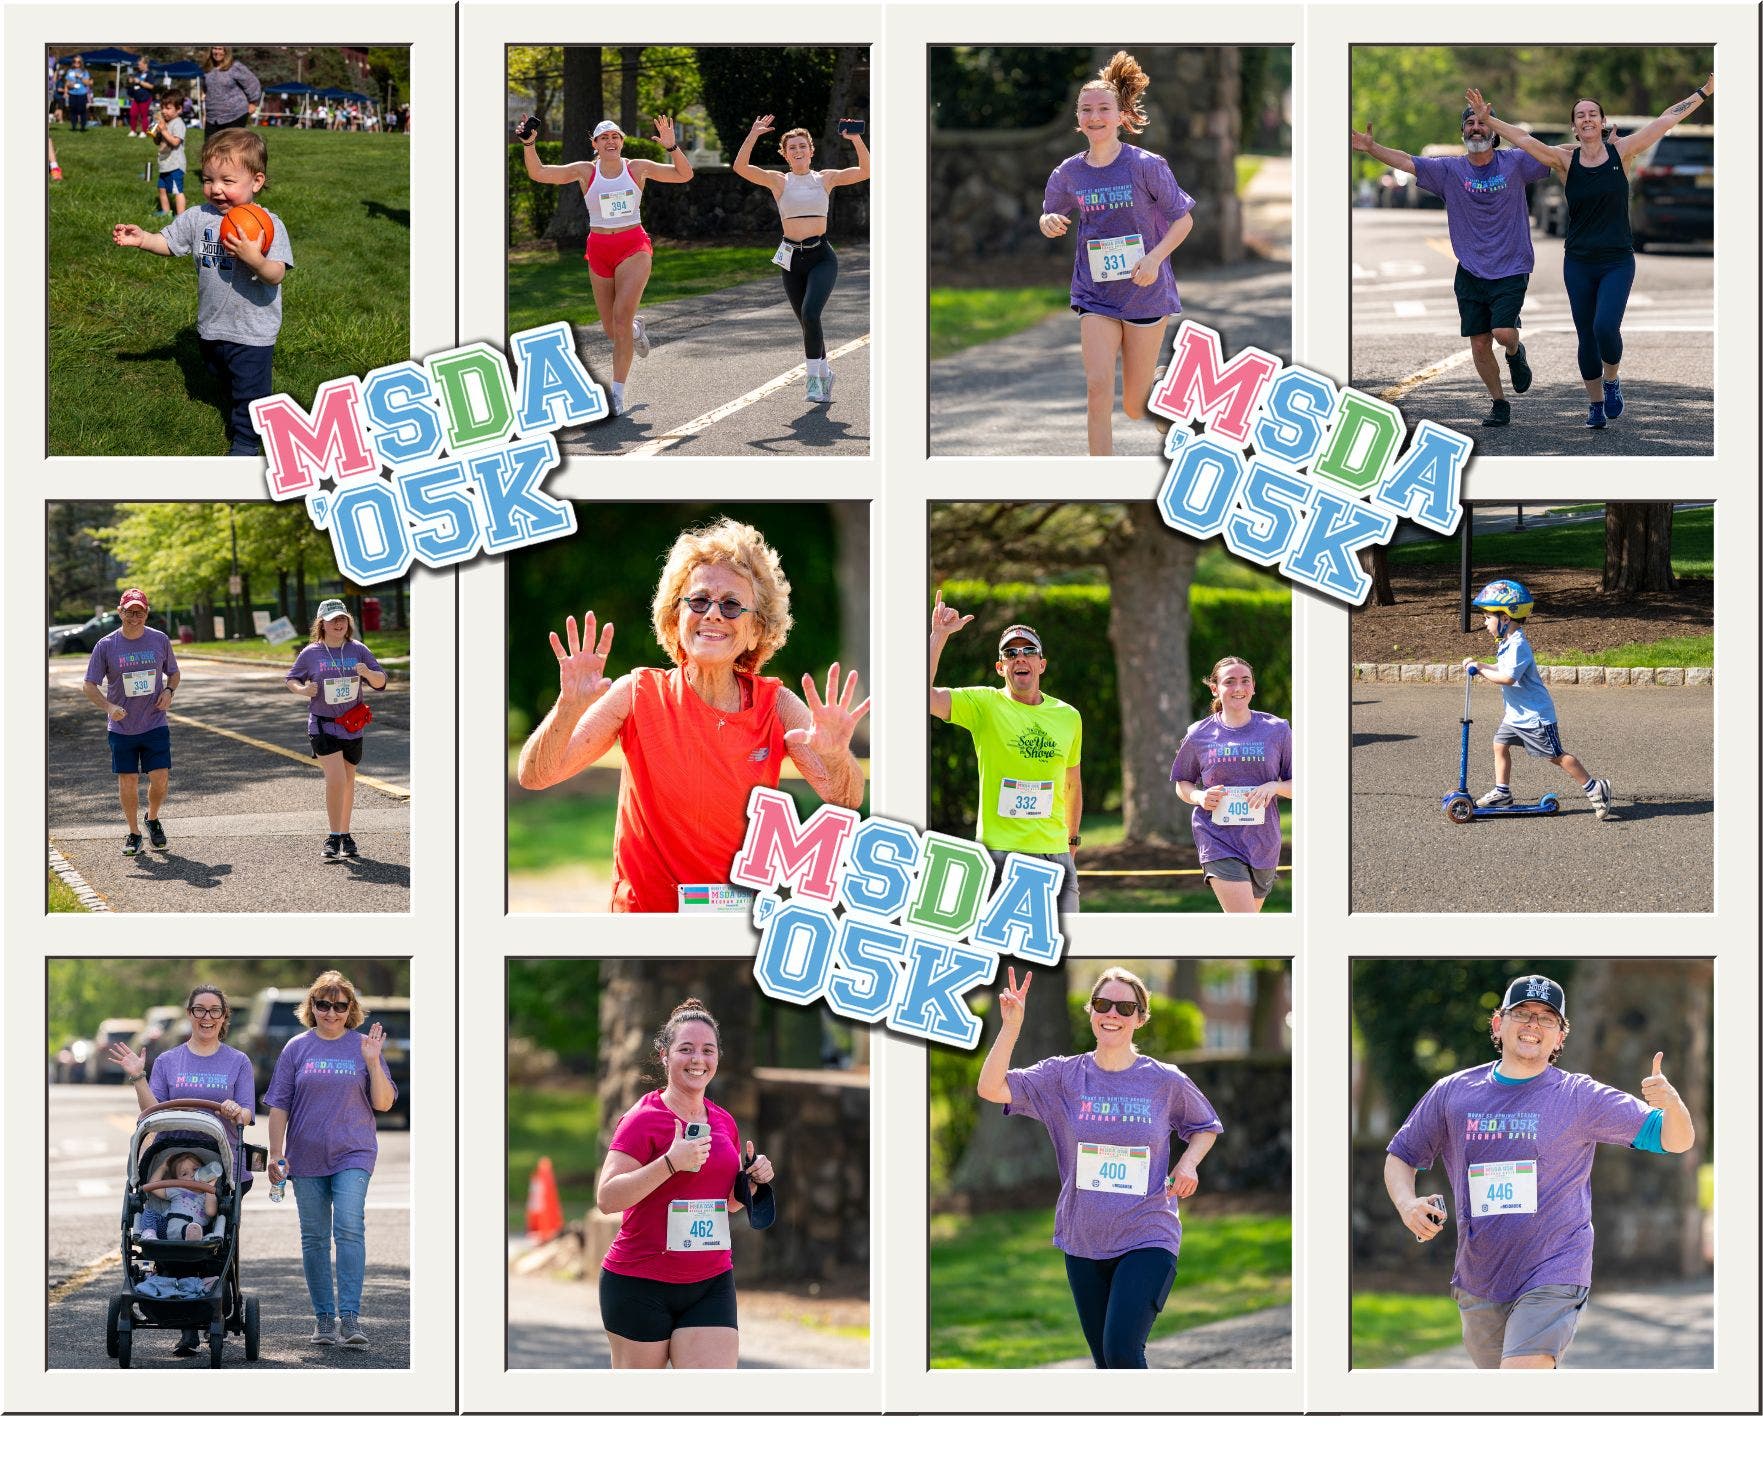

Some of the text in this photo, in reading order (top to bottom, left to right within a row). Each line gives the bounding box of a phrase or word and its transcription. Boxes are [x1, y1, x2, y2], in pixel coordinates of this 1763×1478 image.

[611, 201, 627, 211] 394
[1077, 193, 1105, 206] MSDA
[1104, 254, 1125, 270] 331
[134, 681, 148, 690] 330
[1018, 736, 1034, 747] See
[1034, 737, 1056, 750] You
[1208, 747, 1239, 757] MSDA
[1016, 795, 1037, 810] 332
[1228, 802, 1249, 815] 409
[711, 891, 735, 899] MSDA
[1081, 1101, 1119, 1114] MSDA
[1466, 1119, 1506, 1131] MSDA
[1099, 1162, 1126, 1180] 400
[1487, 1183, 1513, 1201] 446
[690, 1220, 713, 1237] 462
